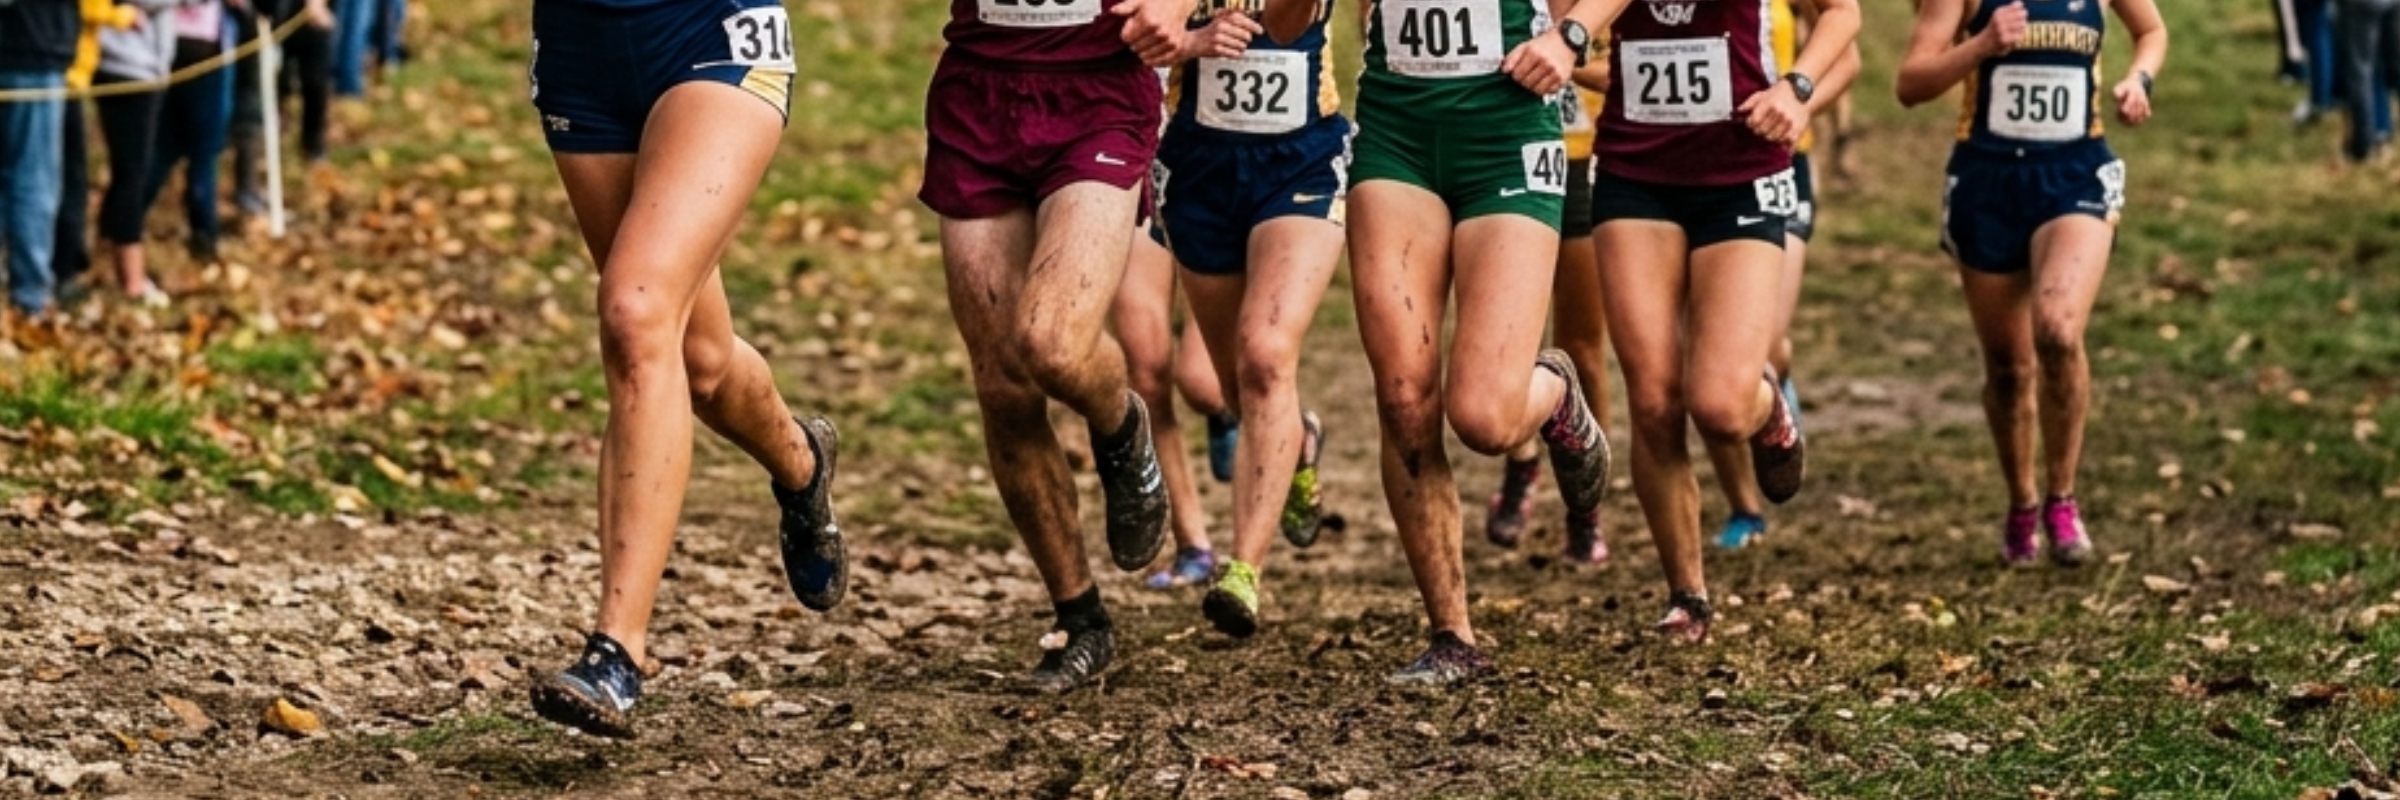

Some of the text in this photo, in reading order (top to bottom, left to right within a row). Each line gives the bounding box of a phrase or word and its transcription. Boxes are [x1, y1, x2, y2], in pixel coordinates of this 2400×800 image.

[1399, 7, 1478, 57] 401
[1215, 68, 1289, 113] 332
[1637, 60, 1711, 105] 215
[2006, 83, 2070, 123] 350
